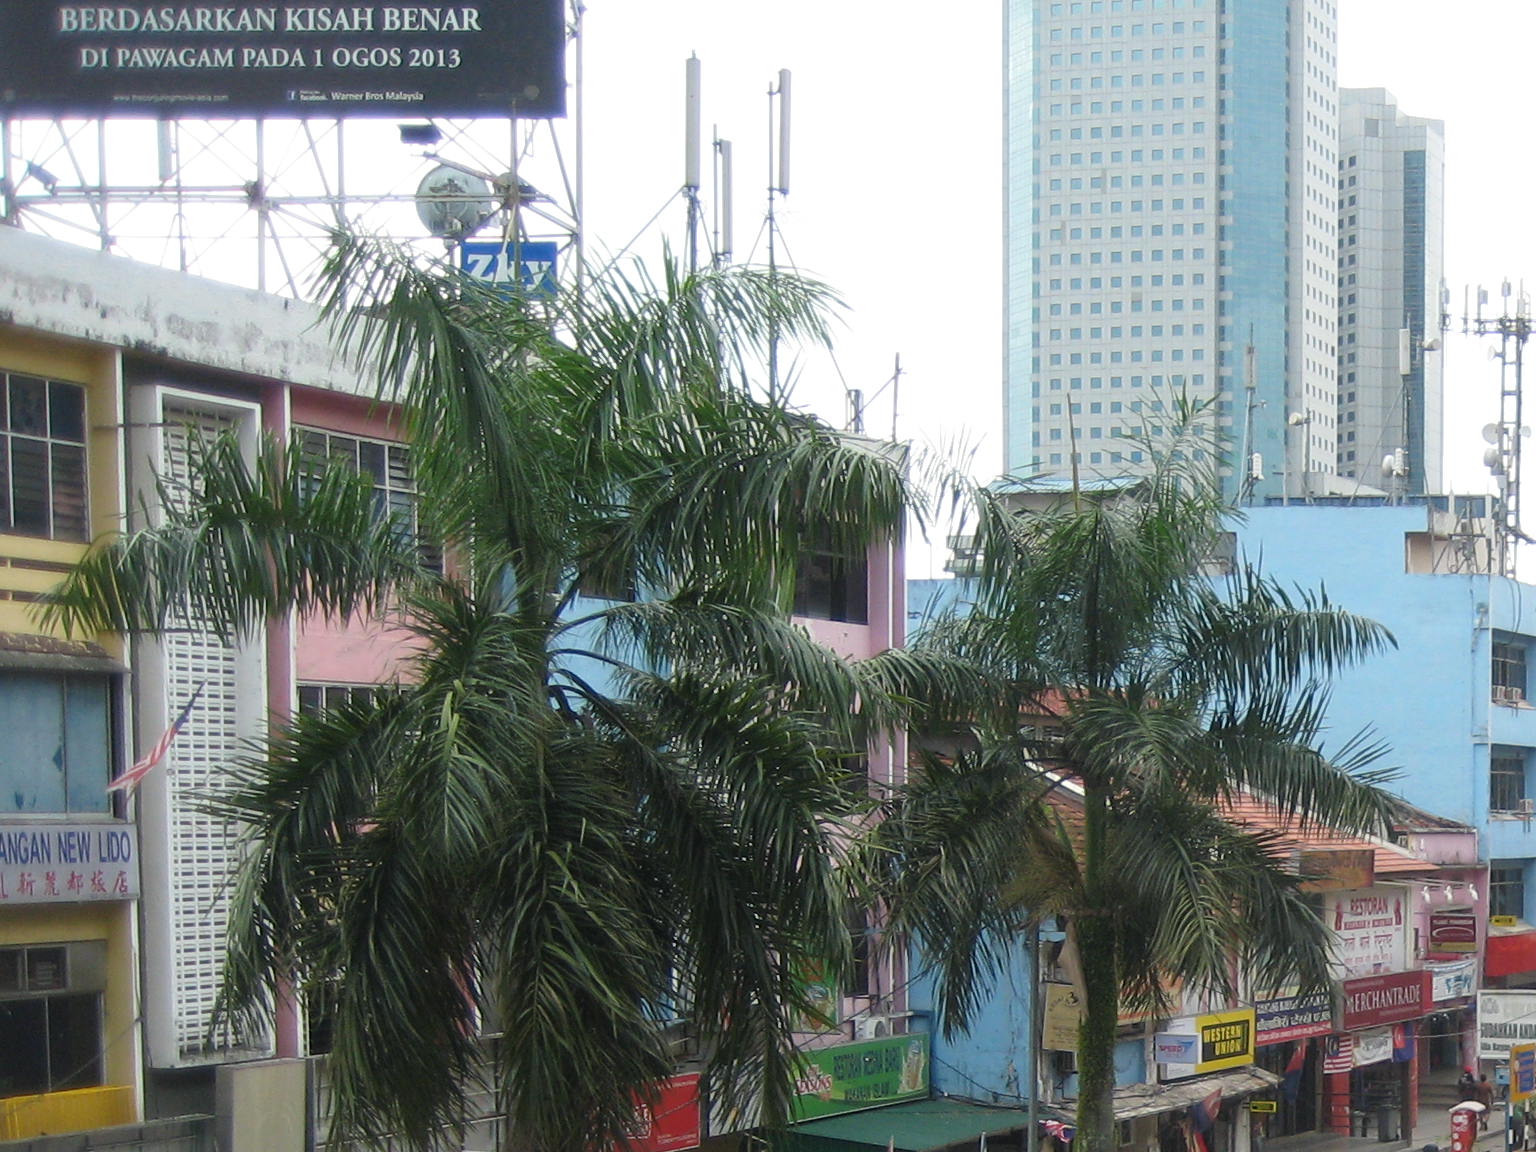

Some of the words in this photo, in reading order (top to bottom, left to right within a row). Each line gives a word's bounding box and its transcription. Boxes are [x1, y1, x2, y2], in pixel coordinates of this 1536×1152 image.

[59, 7, 277, 32] BERDASARKAN
[285, 7, 374, 32] KISAH
[383, 7, 482, 32] BENAR
[80, 48, 108, 68] DI
[116, 48, 234, 68] PAWAGAM
[242, 48, 306, 68] PADA
[314, 49, 323, 67] 1
[332, 47, 402, 68] OGOS
[408, 48, 461, 68] 2013
[331, 91, 364, 101] Warner
[365, 91, 384, 101] Bros
[386, 91, 424, 102] Malaysia
[58, 831, 91, 863] NEW
[99, 831, 131, 863] LIDO
[1350, 897, 1388, 915] RESTORAN
[1344, 985, 1420, 1014] MERCHANTRADE
[1203, 1025, 1242, 1043] WESTERN
[1215, 1039, 1241, 1057] UNION
